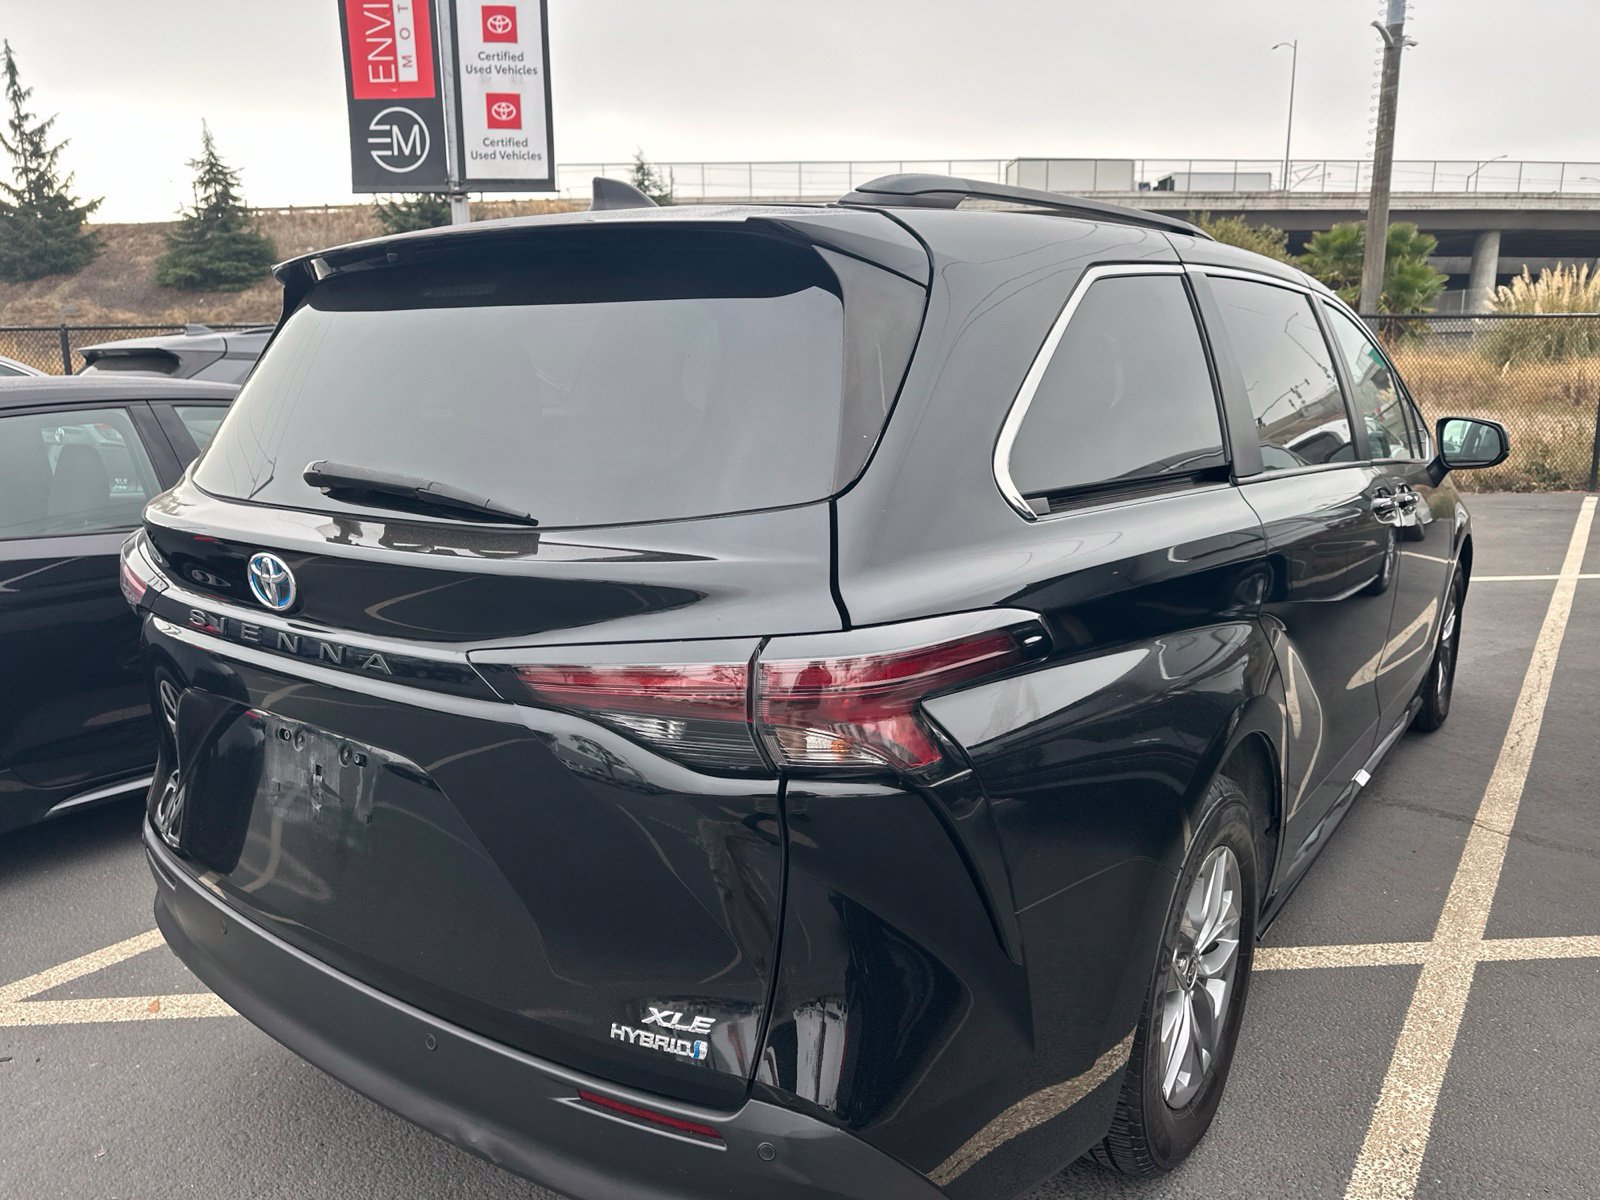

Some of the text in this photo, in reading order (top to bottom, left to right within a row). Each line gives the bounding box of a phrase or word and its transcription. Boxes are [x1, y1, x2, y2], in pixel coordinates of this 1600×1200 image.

[478, 51, 525, 61] Certified
[465, 64, 538, 75] Used Vehicles
[482, 137, 529, 147] Certified
[470, 150, 542, 160] Used Vehicles
[189, 608, 393, 676] SIENNA
[641, 1006, 717, 1035] XLE
[610, 1022, 694, 1058] HYBRID
